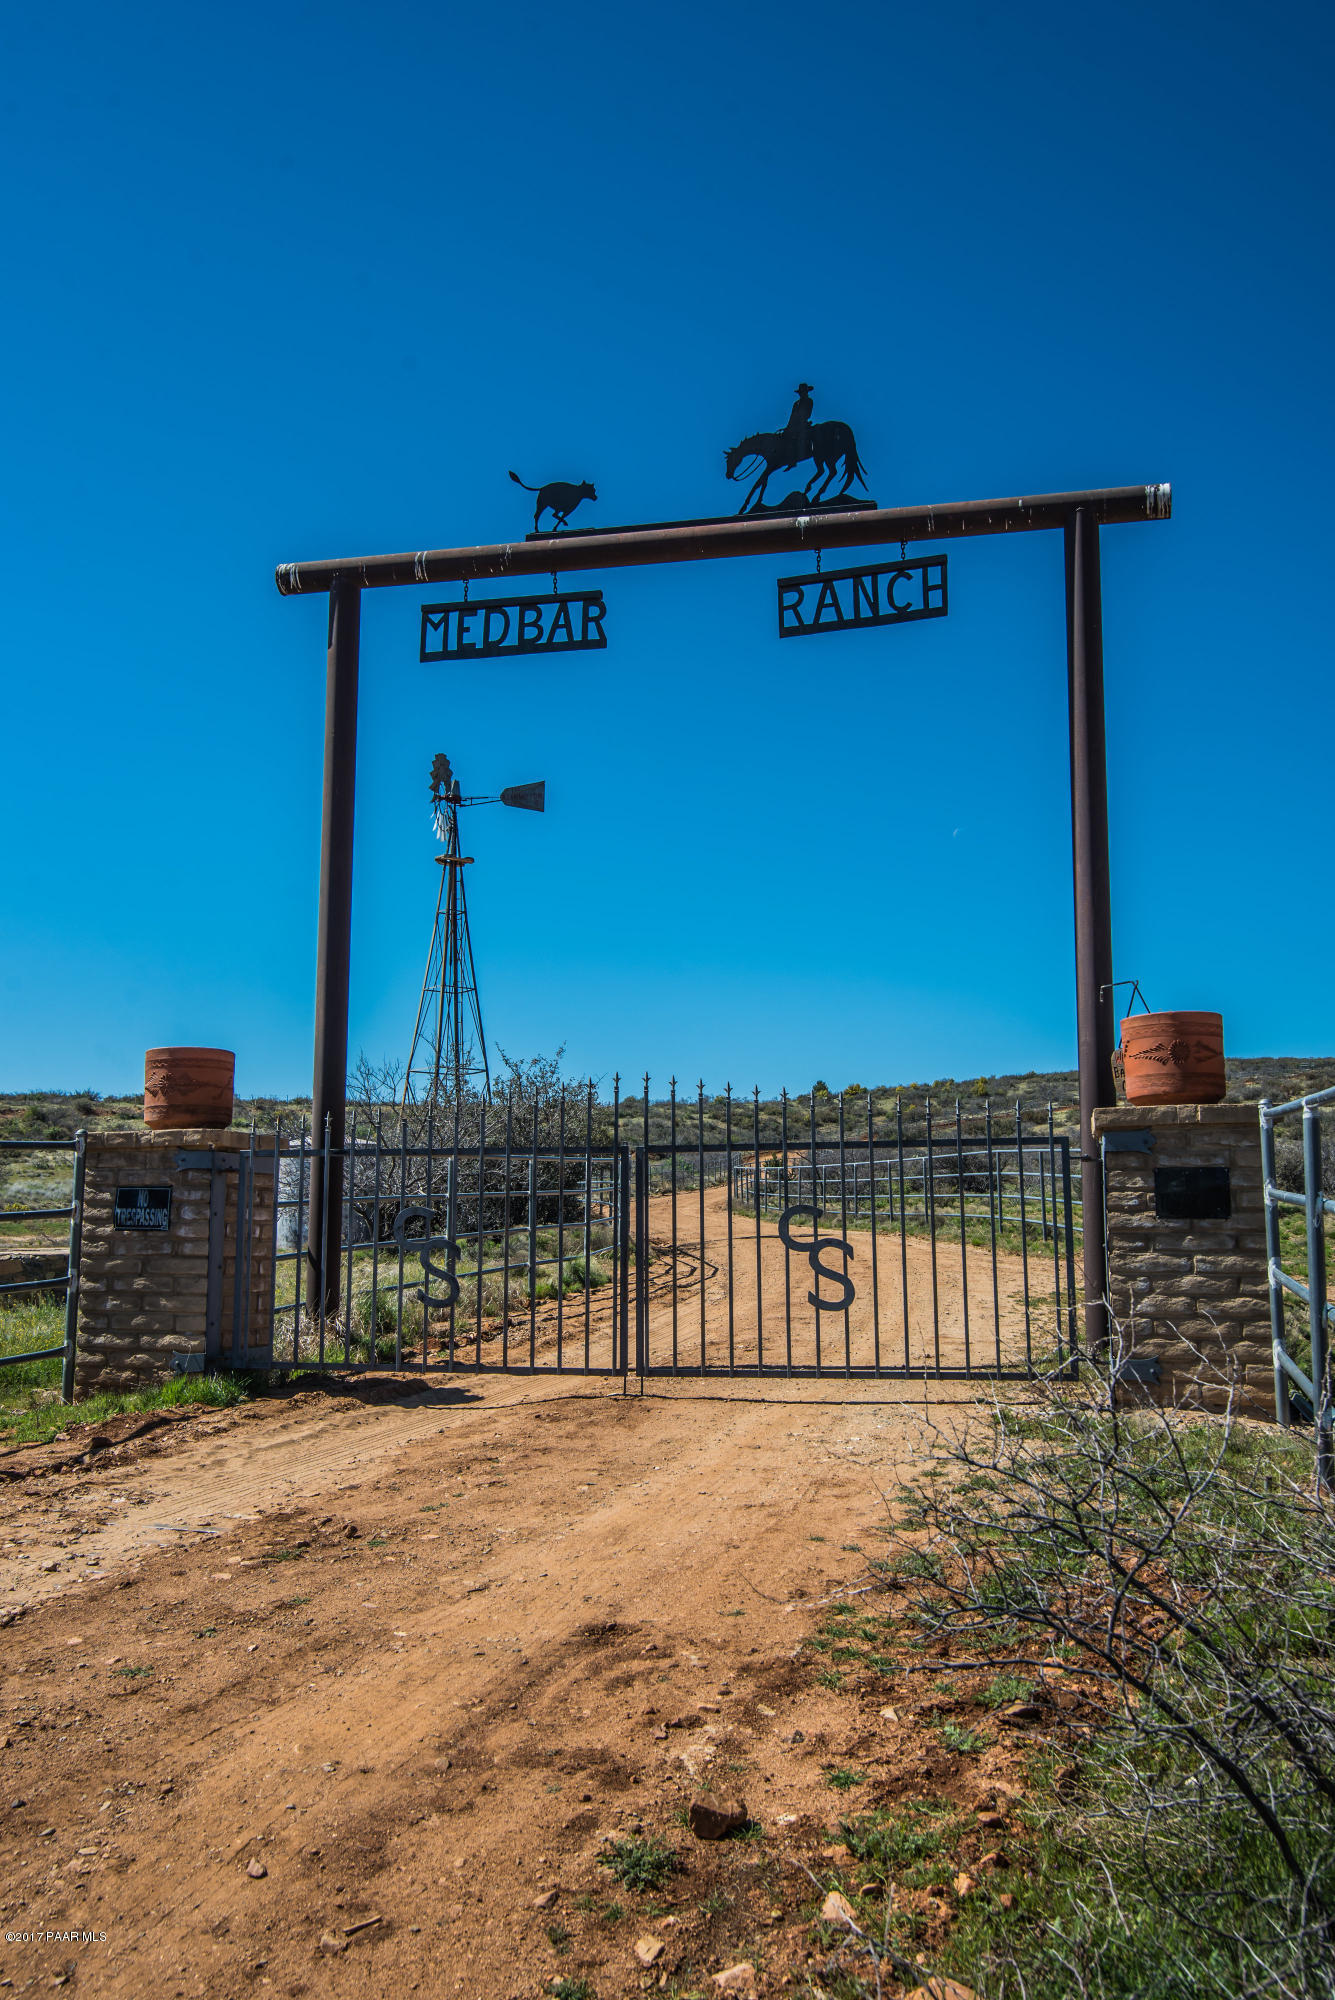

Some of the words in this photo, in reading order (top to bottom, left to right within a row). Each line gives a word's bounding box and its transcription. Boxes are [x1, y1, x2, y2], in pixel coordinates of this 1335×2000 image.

[778, 560, 948, 636] RANCH
[421, 597, 607, 661] MEDBAR
[115, 1208, 168, 1226] TRESPASSING
[137, 1190, 149, 1207] NO
